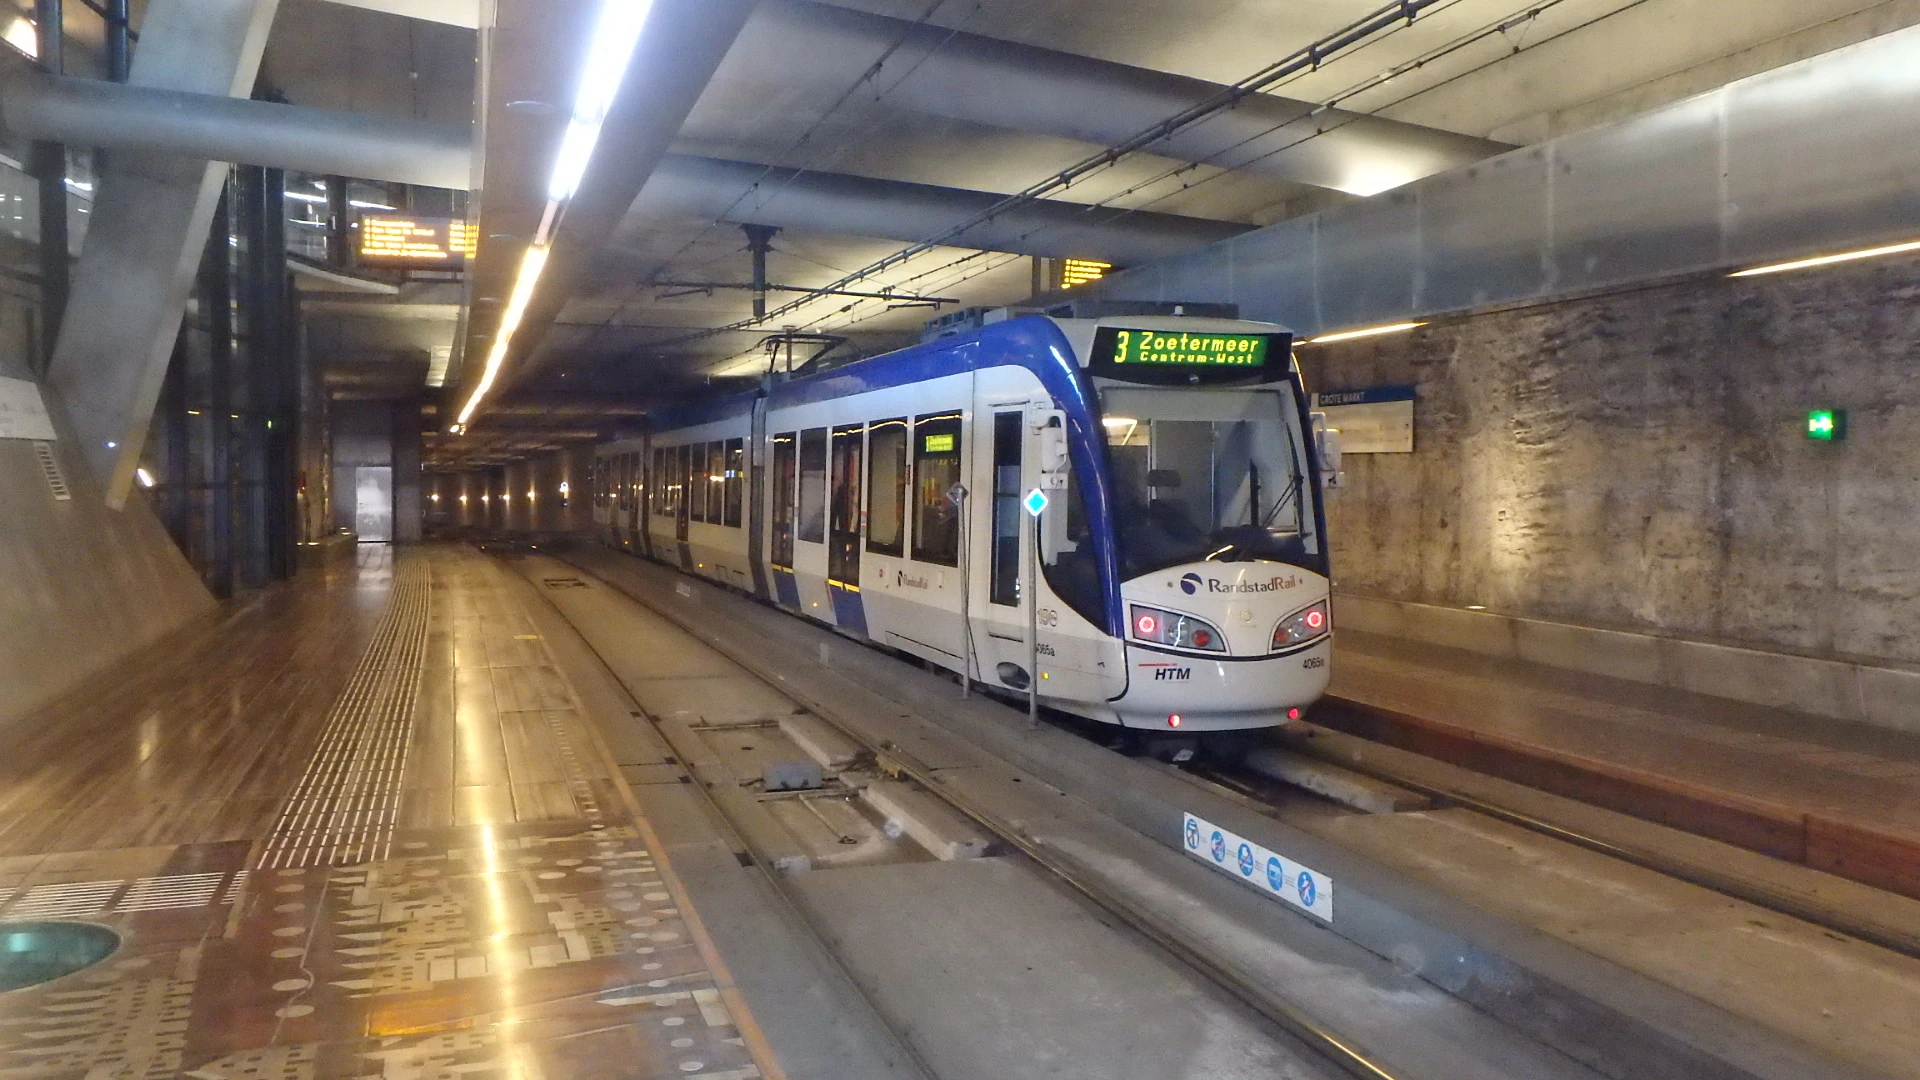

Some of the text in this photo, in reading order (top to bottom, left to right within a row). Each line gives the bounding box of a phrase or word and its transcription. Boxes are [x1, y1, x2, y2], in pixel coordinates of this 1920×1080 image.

[1114, 331, 1259, 363] 3 Zoetermeer
[1140, 351, 1253, 364] Centrum-West
[1208, 575, 1296, 593] RandstadRail
[1154, 667, 1191, 681] HTM
